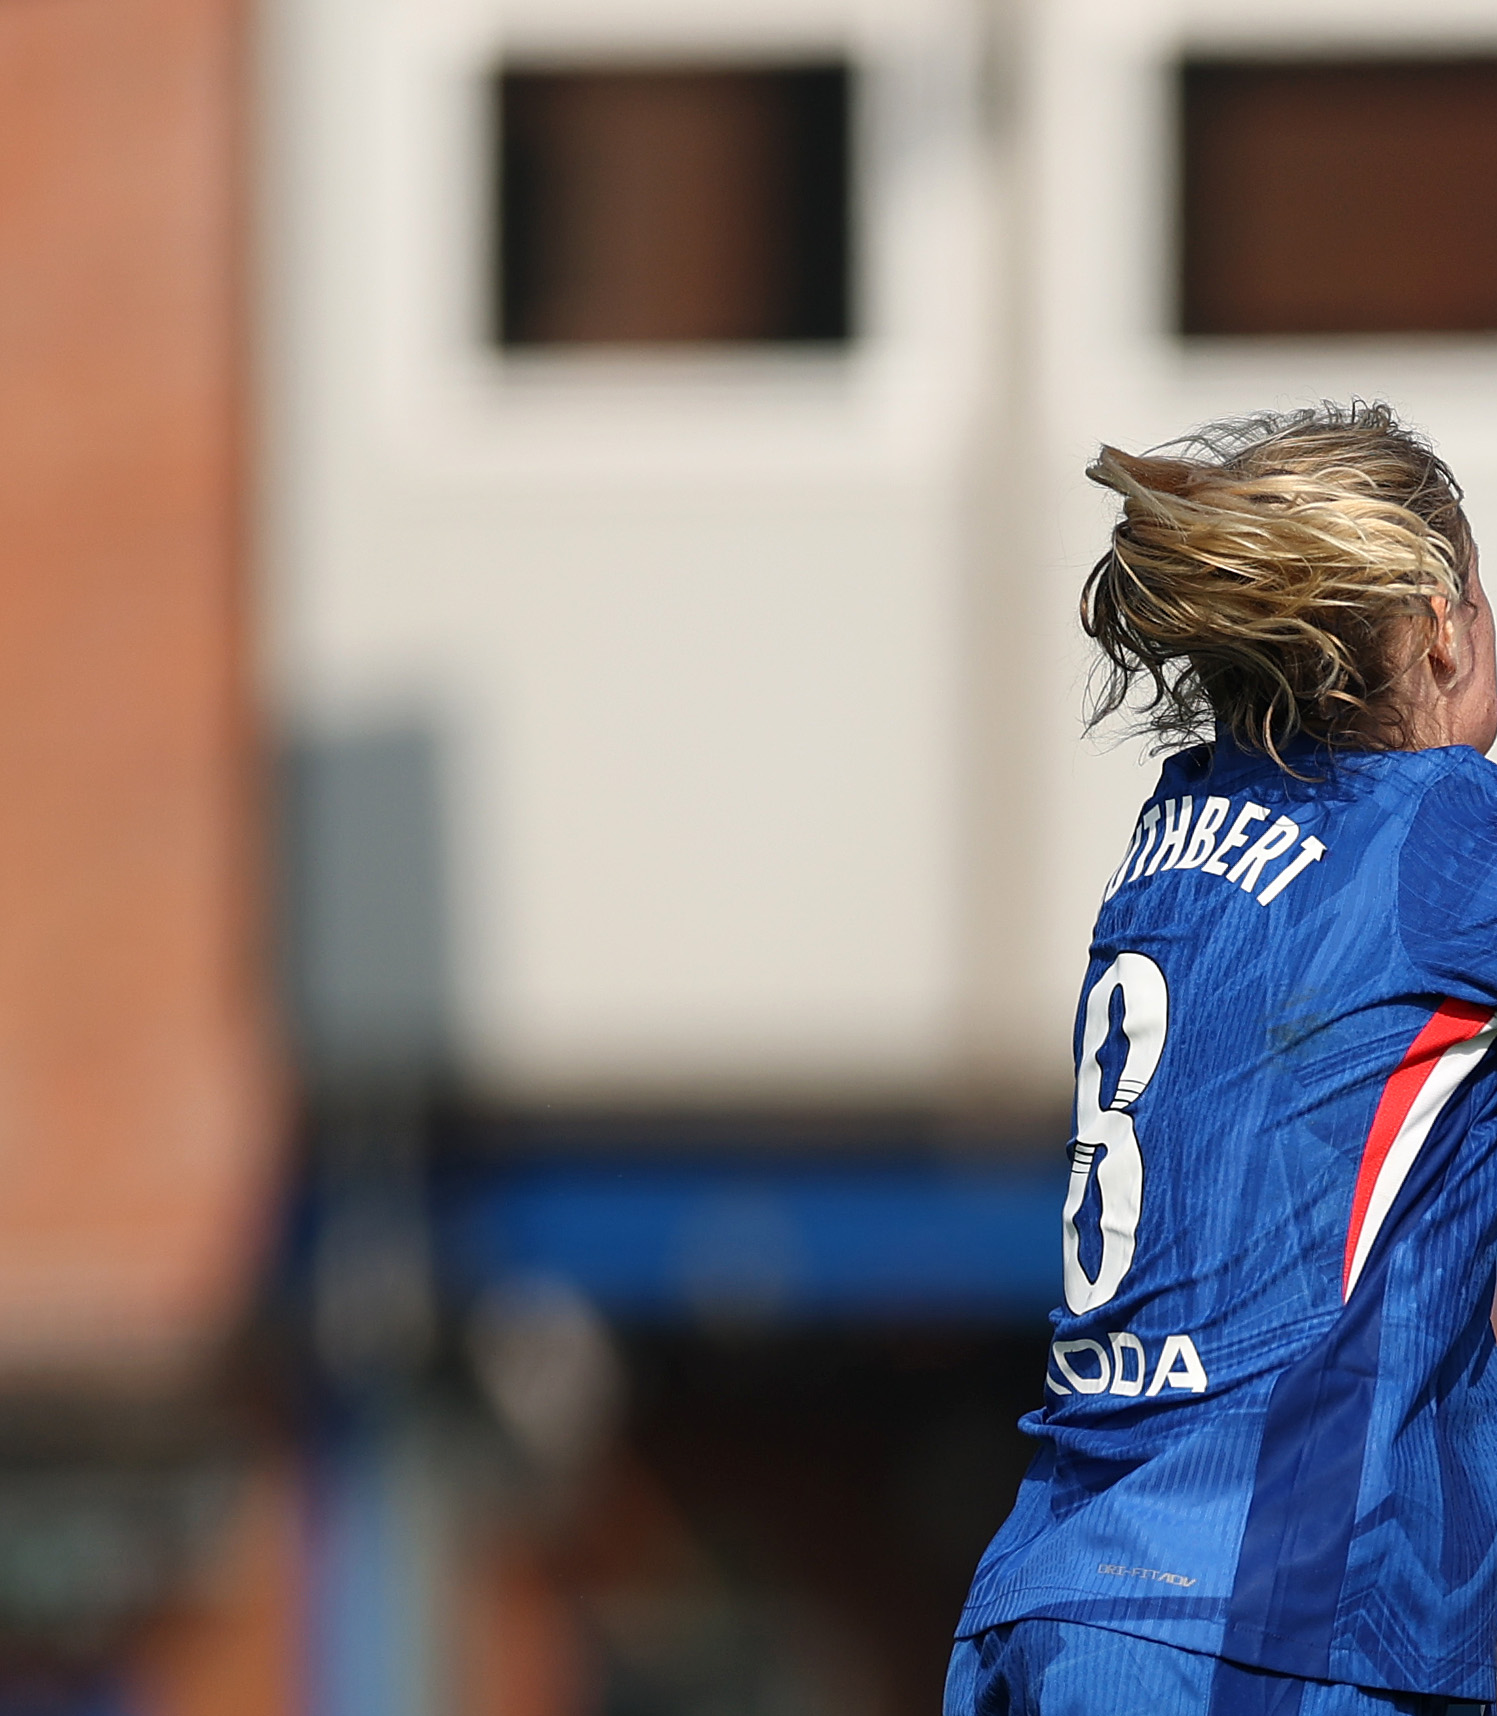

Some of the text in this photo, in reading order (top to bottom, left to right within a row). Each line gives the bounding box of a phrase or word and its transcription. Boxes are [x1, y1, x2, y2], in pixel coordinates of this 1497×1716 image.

[1103, 794, 1328, 907] UTHBERT
[1063, 951, 1169, 1316] 8
[1046, 1331, 1208, 1397] ODA
